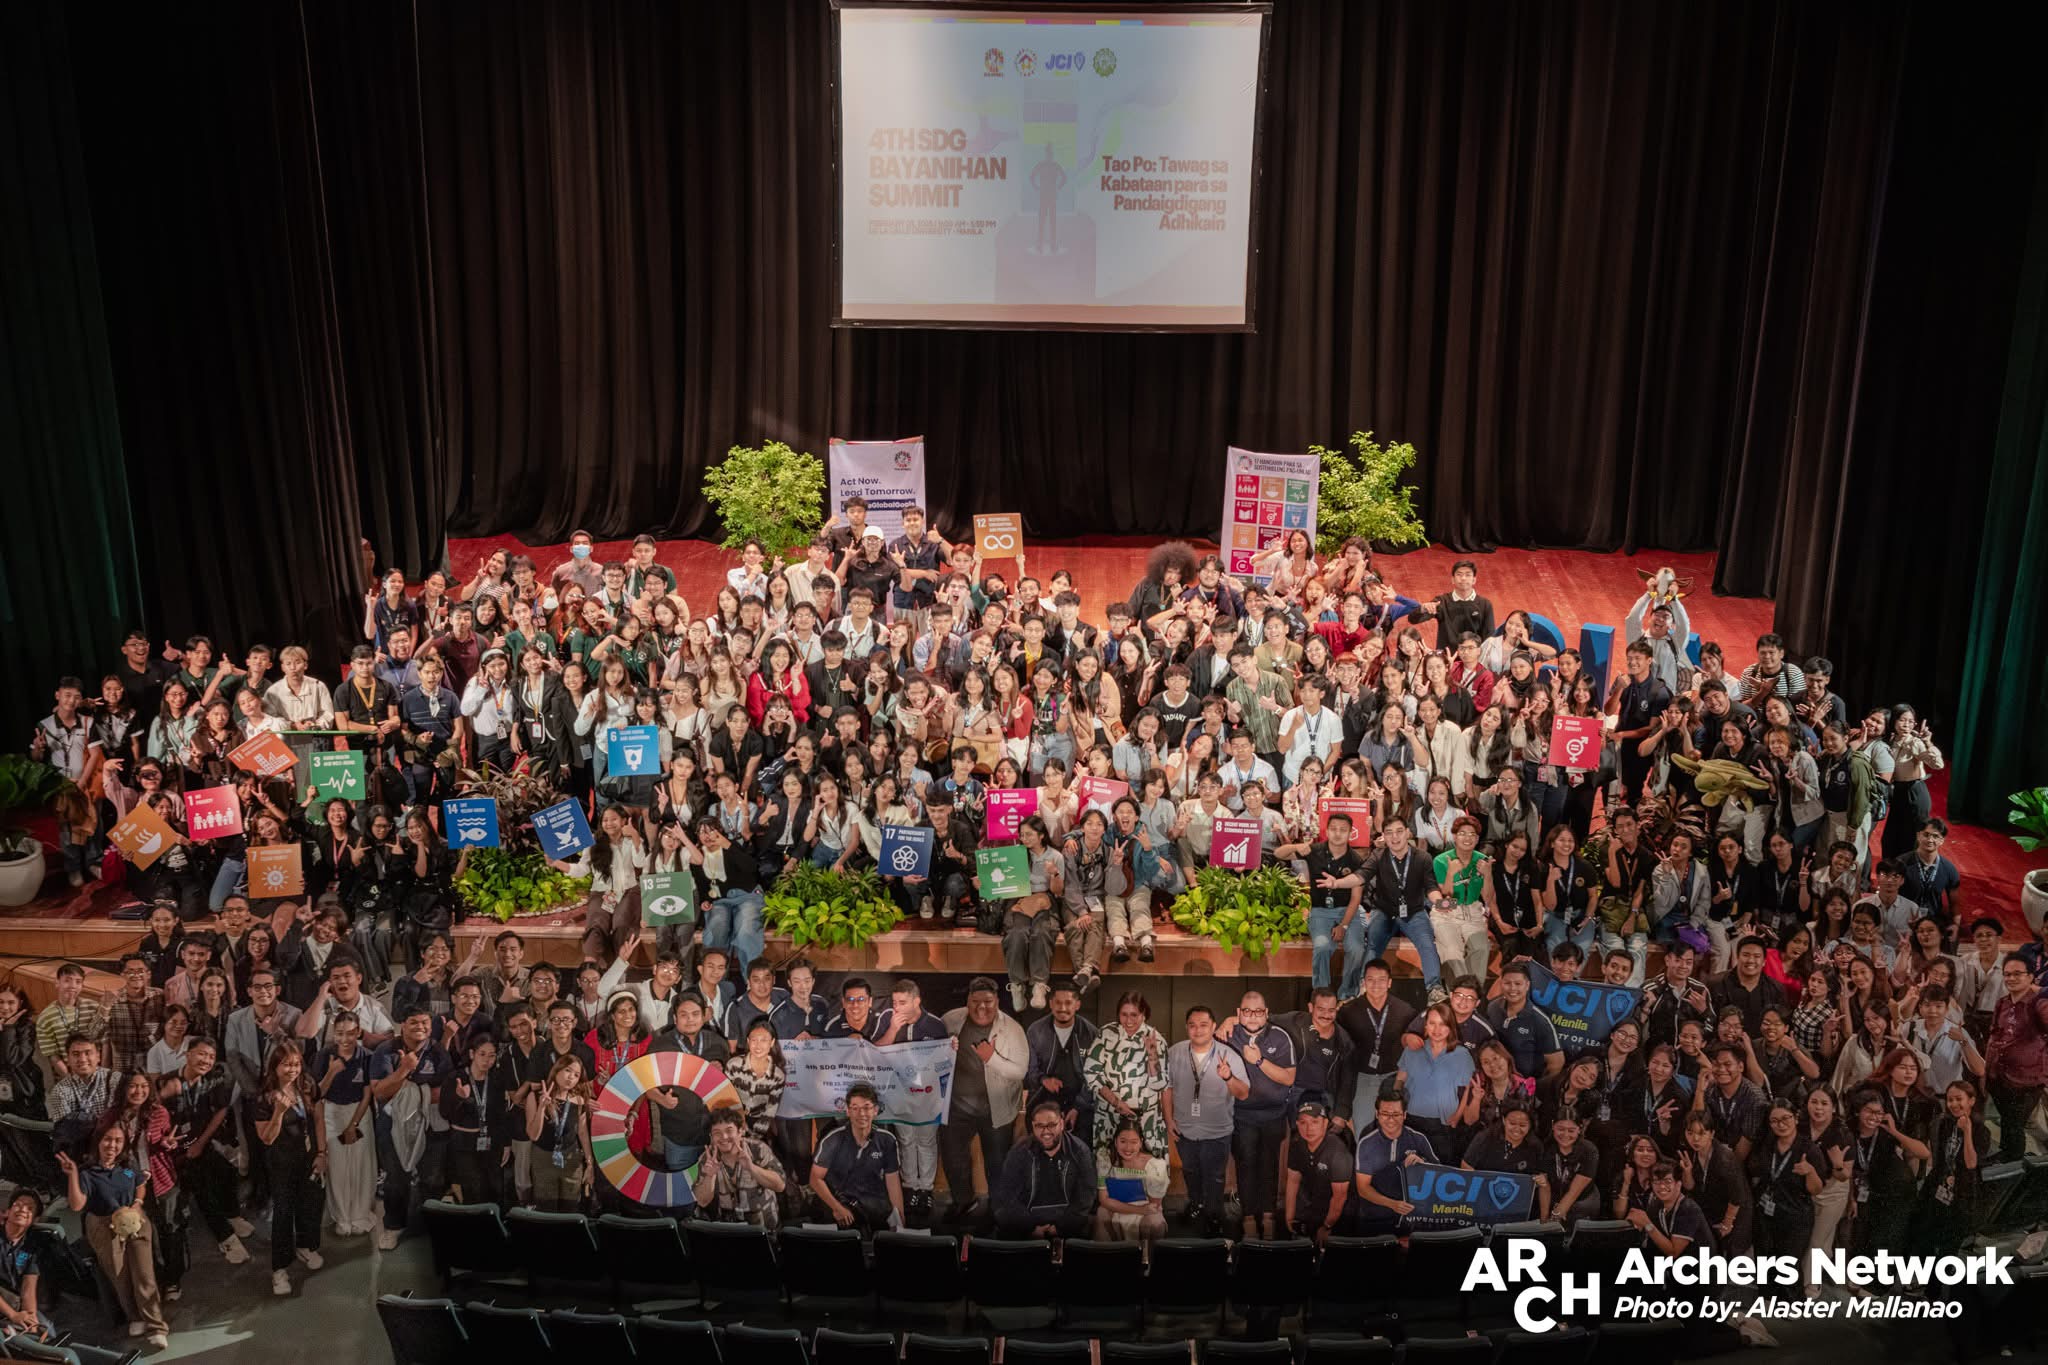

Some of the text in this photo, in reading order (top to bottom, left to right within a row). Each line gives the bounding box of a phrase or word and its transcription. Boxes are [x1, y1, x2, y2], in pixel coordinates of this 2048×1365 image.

[1045, 54, 1072, 70] JCI
[869, 128, 967, 152] 4TH SDG
[870, 156, 1007, 180] BAYANIHAN
[1102, 156, 1228, 176] Tao Po: Tawag sa
[1101, 175, 1228, 194] Kabataan para sa
[870, 184, 963, 208] SUMMIT
[1114, 194, 1226, 215] Pandaigdigang
[1160, 213, 1225, 230] Adhikain
[840, 478, 882, 486] Act Now.
[840, 488, 916, 498] Lead Tomorrow.
[976, 518, 986, 528] 12
[1556, 719, 1563, 730] 5
[611, 731, 617, 742] 6
[313, 756, 321, 767] 3
[1084, 779, 1091, 791] 4
[187, 795, 194, 807] 1
[990, 793, 1001, 804] 10
[446, 804, 458, 814] 14
[535, 815, 547, 829] 16
[1215, 820, 1223, 832] 8
[112, 831, 123, 842] 2
[885, 828, 896, 840] 17
[978, 853, 989, 865] 15
[643, 878, 654, 890] 13
[1531, 979, 1602, 1017] JCI
[1551, 1013, 1588, 1031] Manila
[1571, 1035, 1584, 1044] OF
[1408, 1170, 1484, 1203] JCI
[1432, 1204, 1474, 1216] Manila
[1406, 1216, 1455, 1224] NIVERSITY
